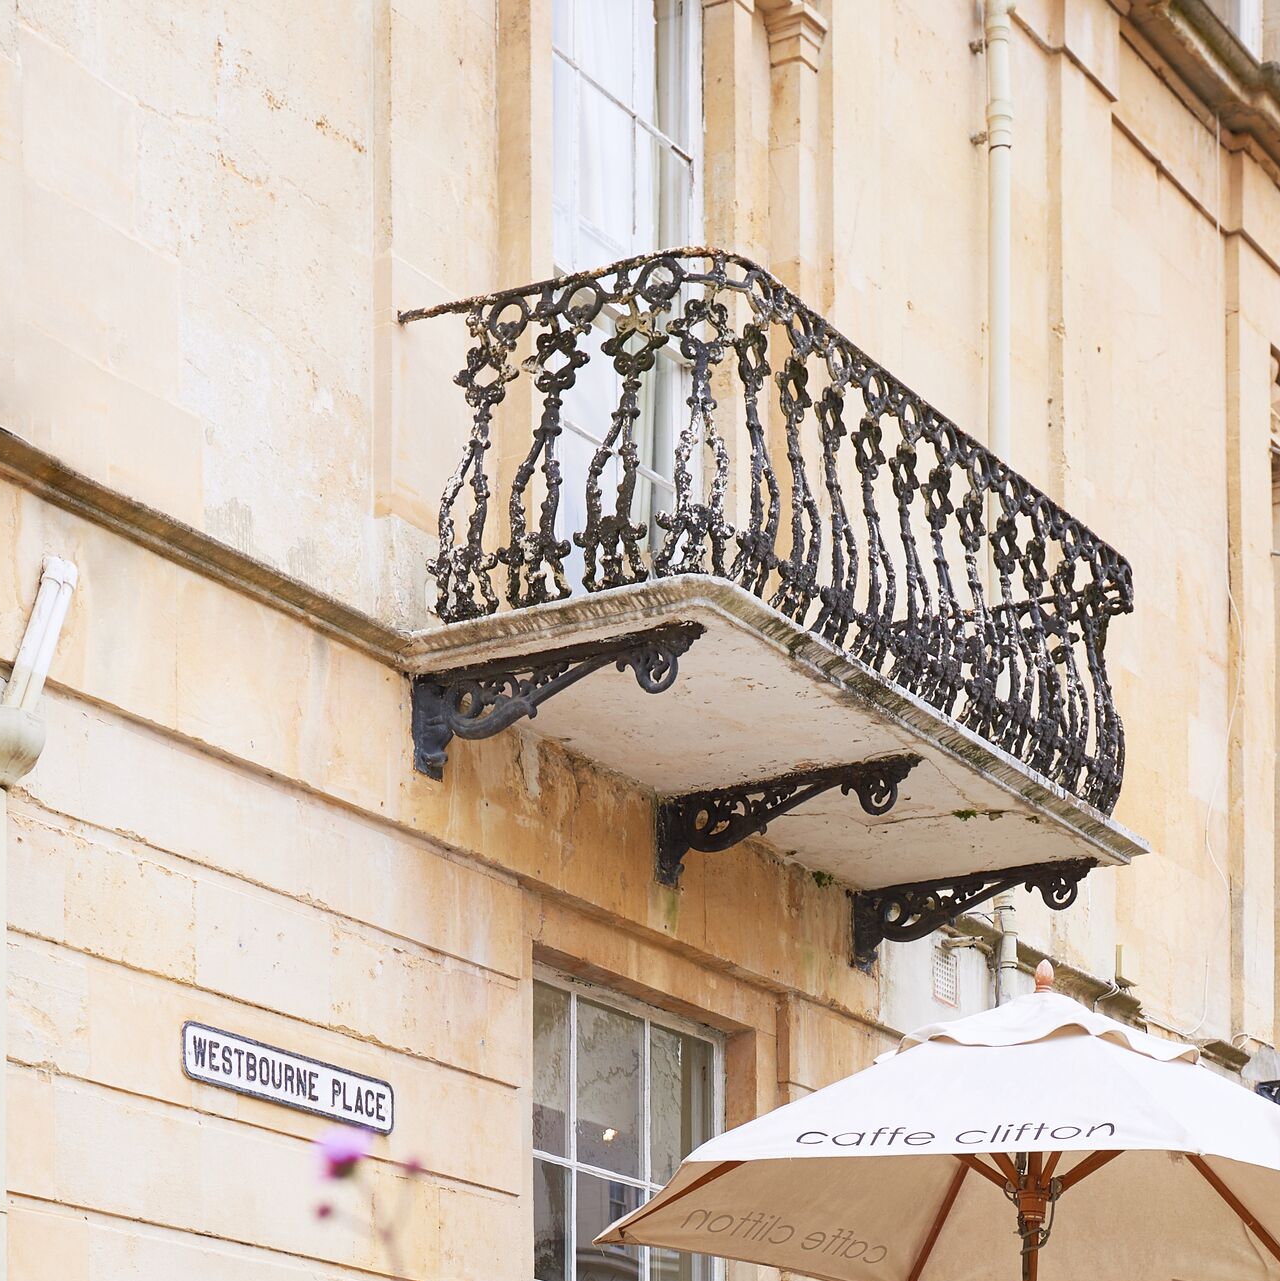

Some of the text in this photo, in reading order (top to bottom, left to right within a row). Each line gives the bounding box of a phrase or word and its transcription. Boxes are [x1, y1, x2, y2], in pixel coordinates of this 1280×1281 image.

[192, 1035, 387, 1122] WESTBOURNE PLACE
[796, 1122, 1115, 1147] caffe clifton
